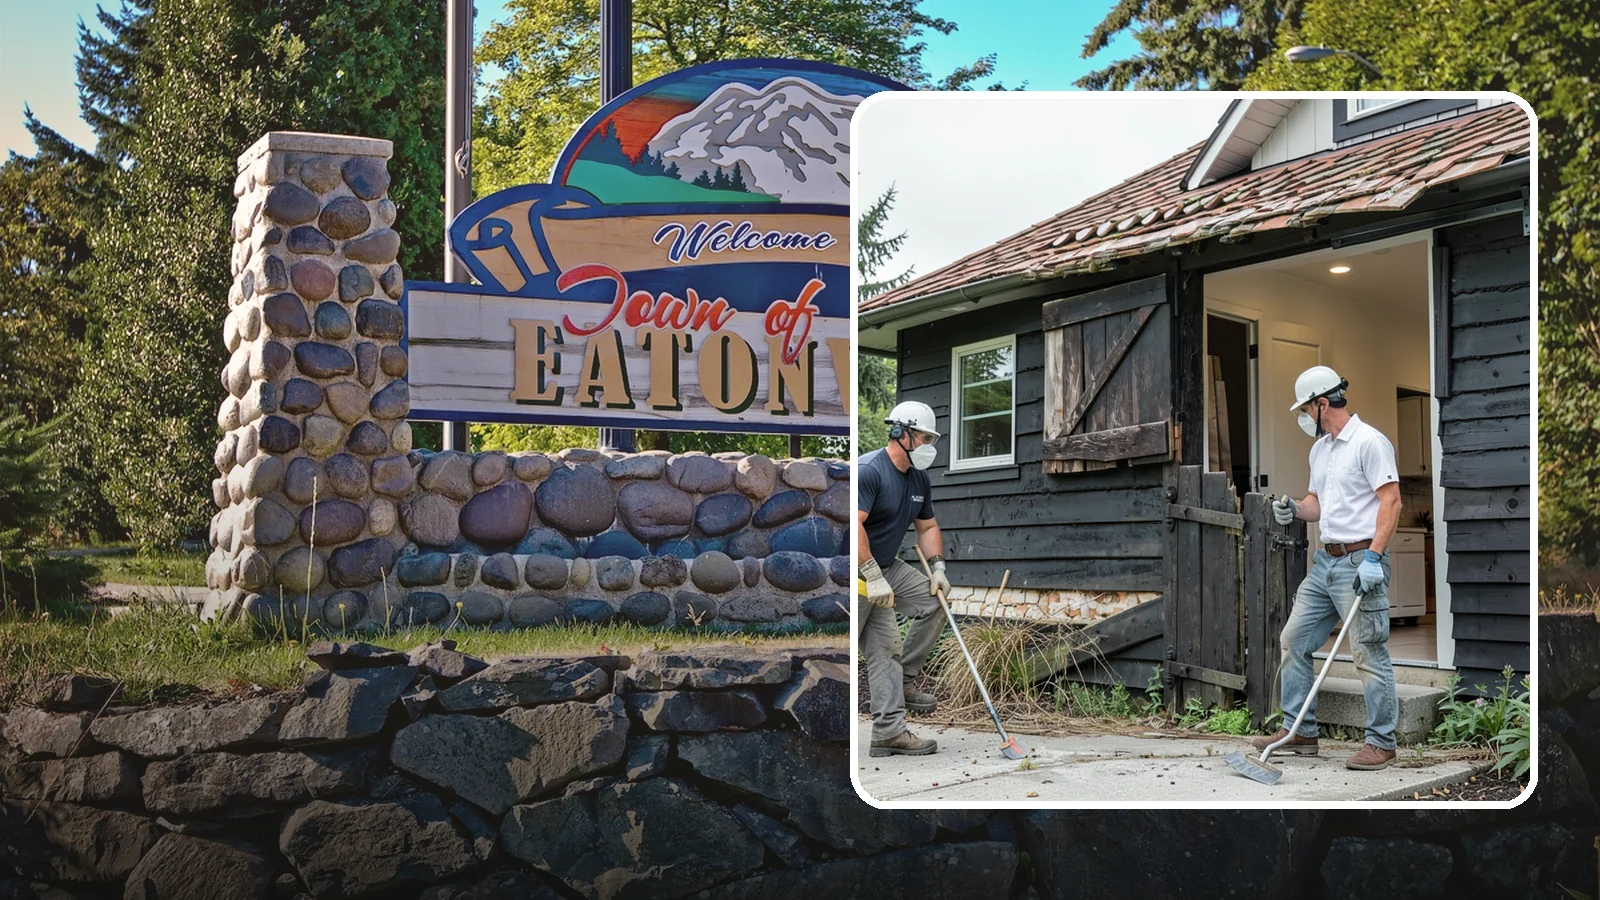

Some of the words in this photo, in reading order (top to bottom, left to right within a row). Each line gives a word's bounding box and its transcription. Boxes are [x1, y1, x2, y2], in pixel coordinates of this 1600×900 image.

[653, 221, 836, 263] Welcome
[557, 263, 736, 336] Town
[765, 278, 825, 365] of
